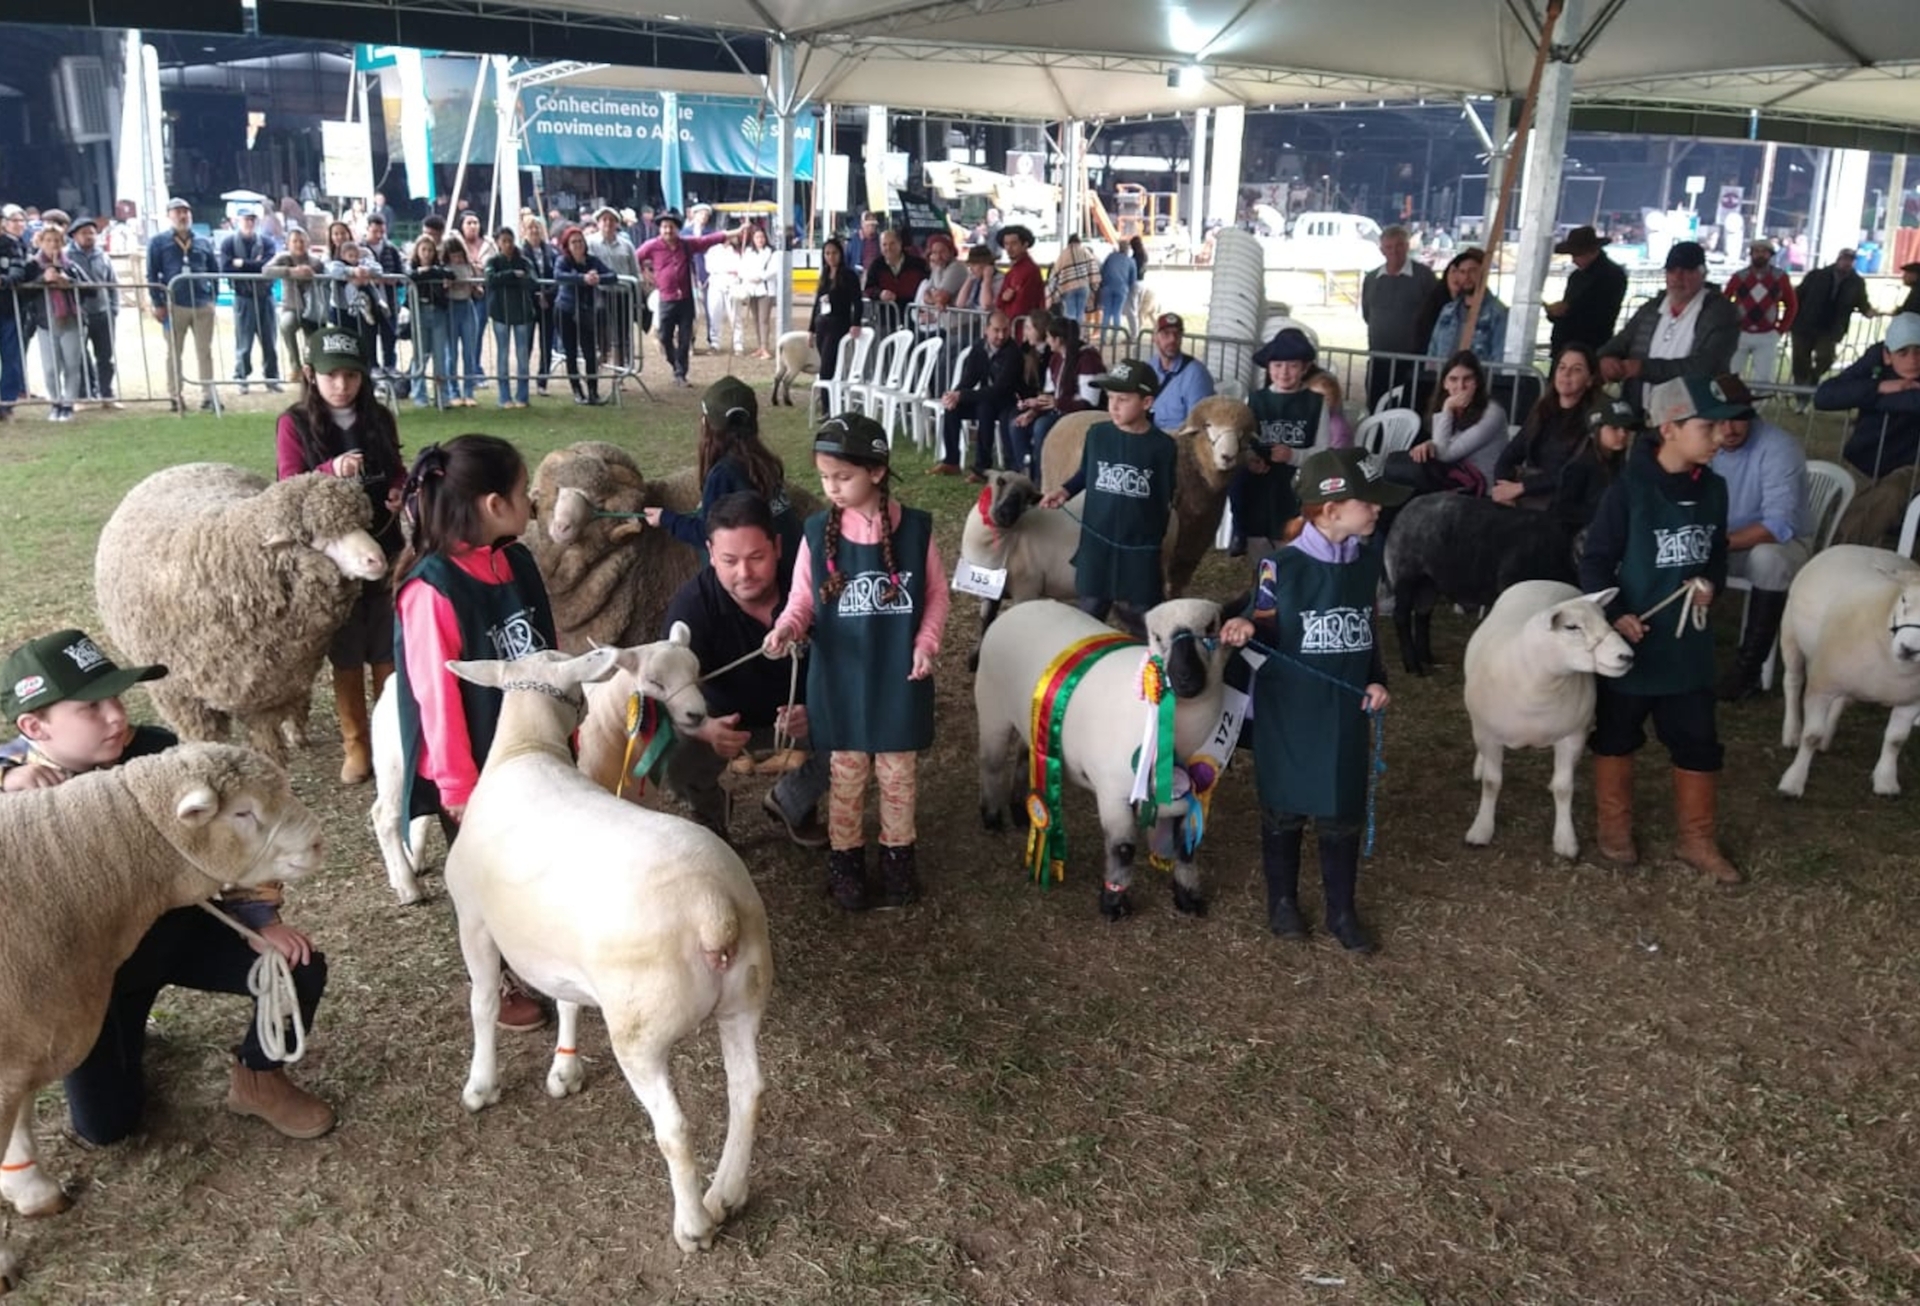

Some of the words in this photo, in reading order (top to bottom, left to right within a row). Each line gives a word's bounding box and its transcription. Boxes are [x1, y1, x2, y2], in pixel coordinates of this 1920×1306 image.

[535, 95, 659, 118] Conhecimento
[536, 118, 633, 138] movimenta
[636, 126, 647, 139] o
[651, 124, 695, 142] Ao.
[769, 124, 812, 140] SAR
[1301, 612, 1373, 649] ARCO
[1214, 711, 1233, 746] 172
